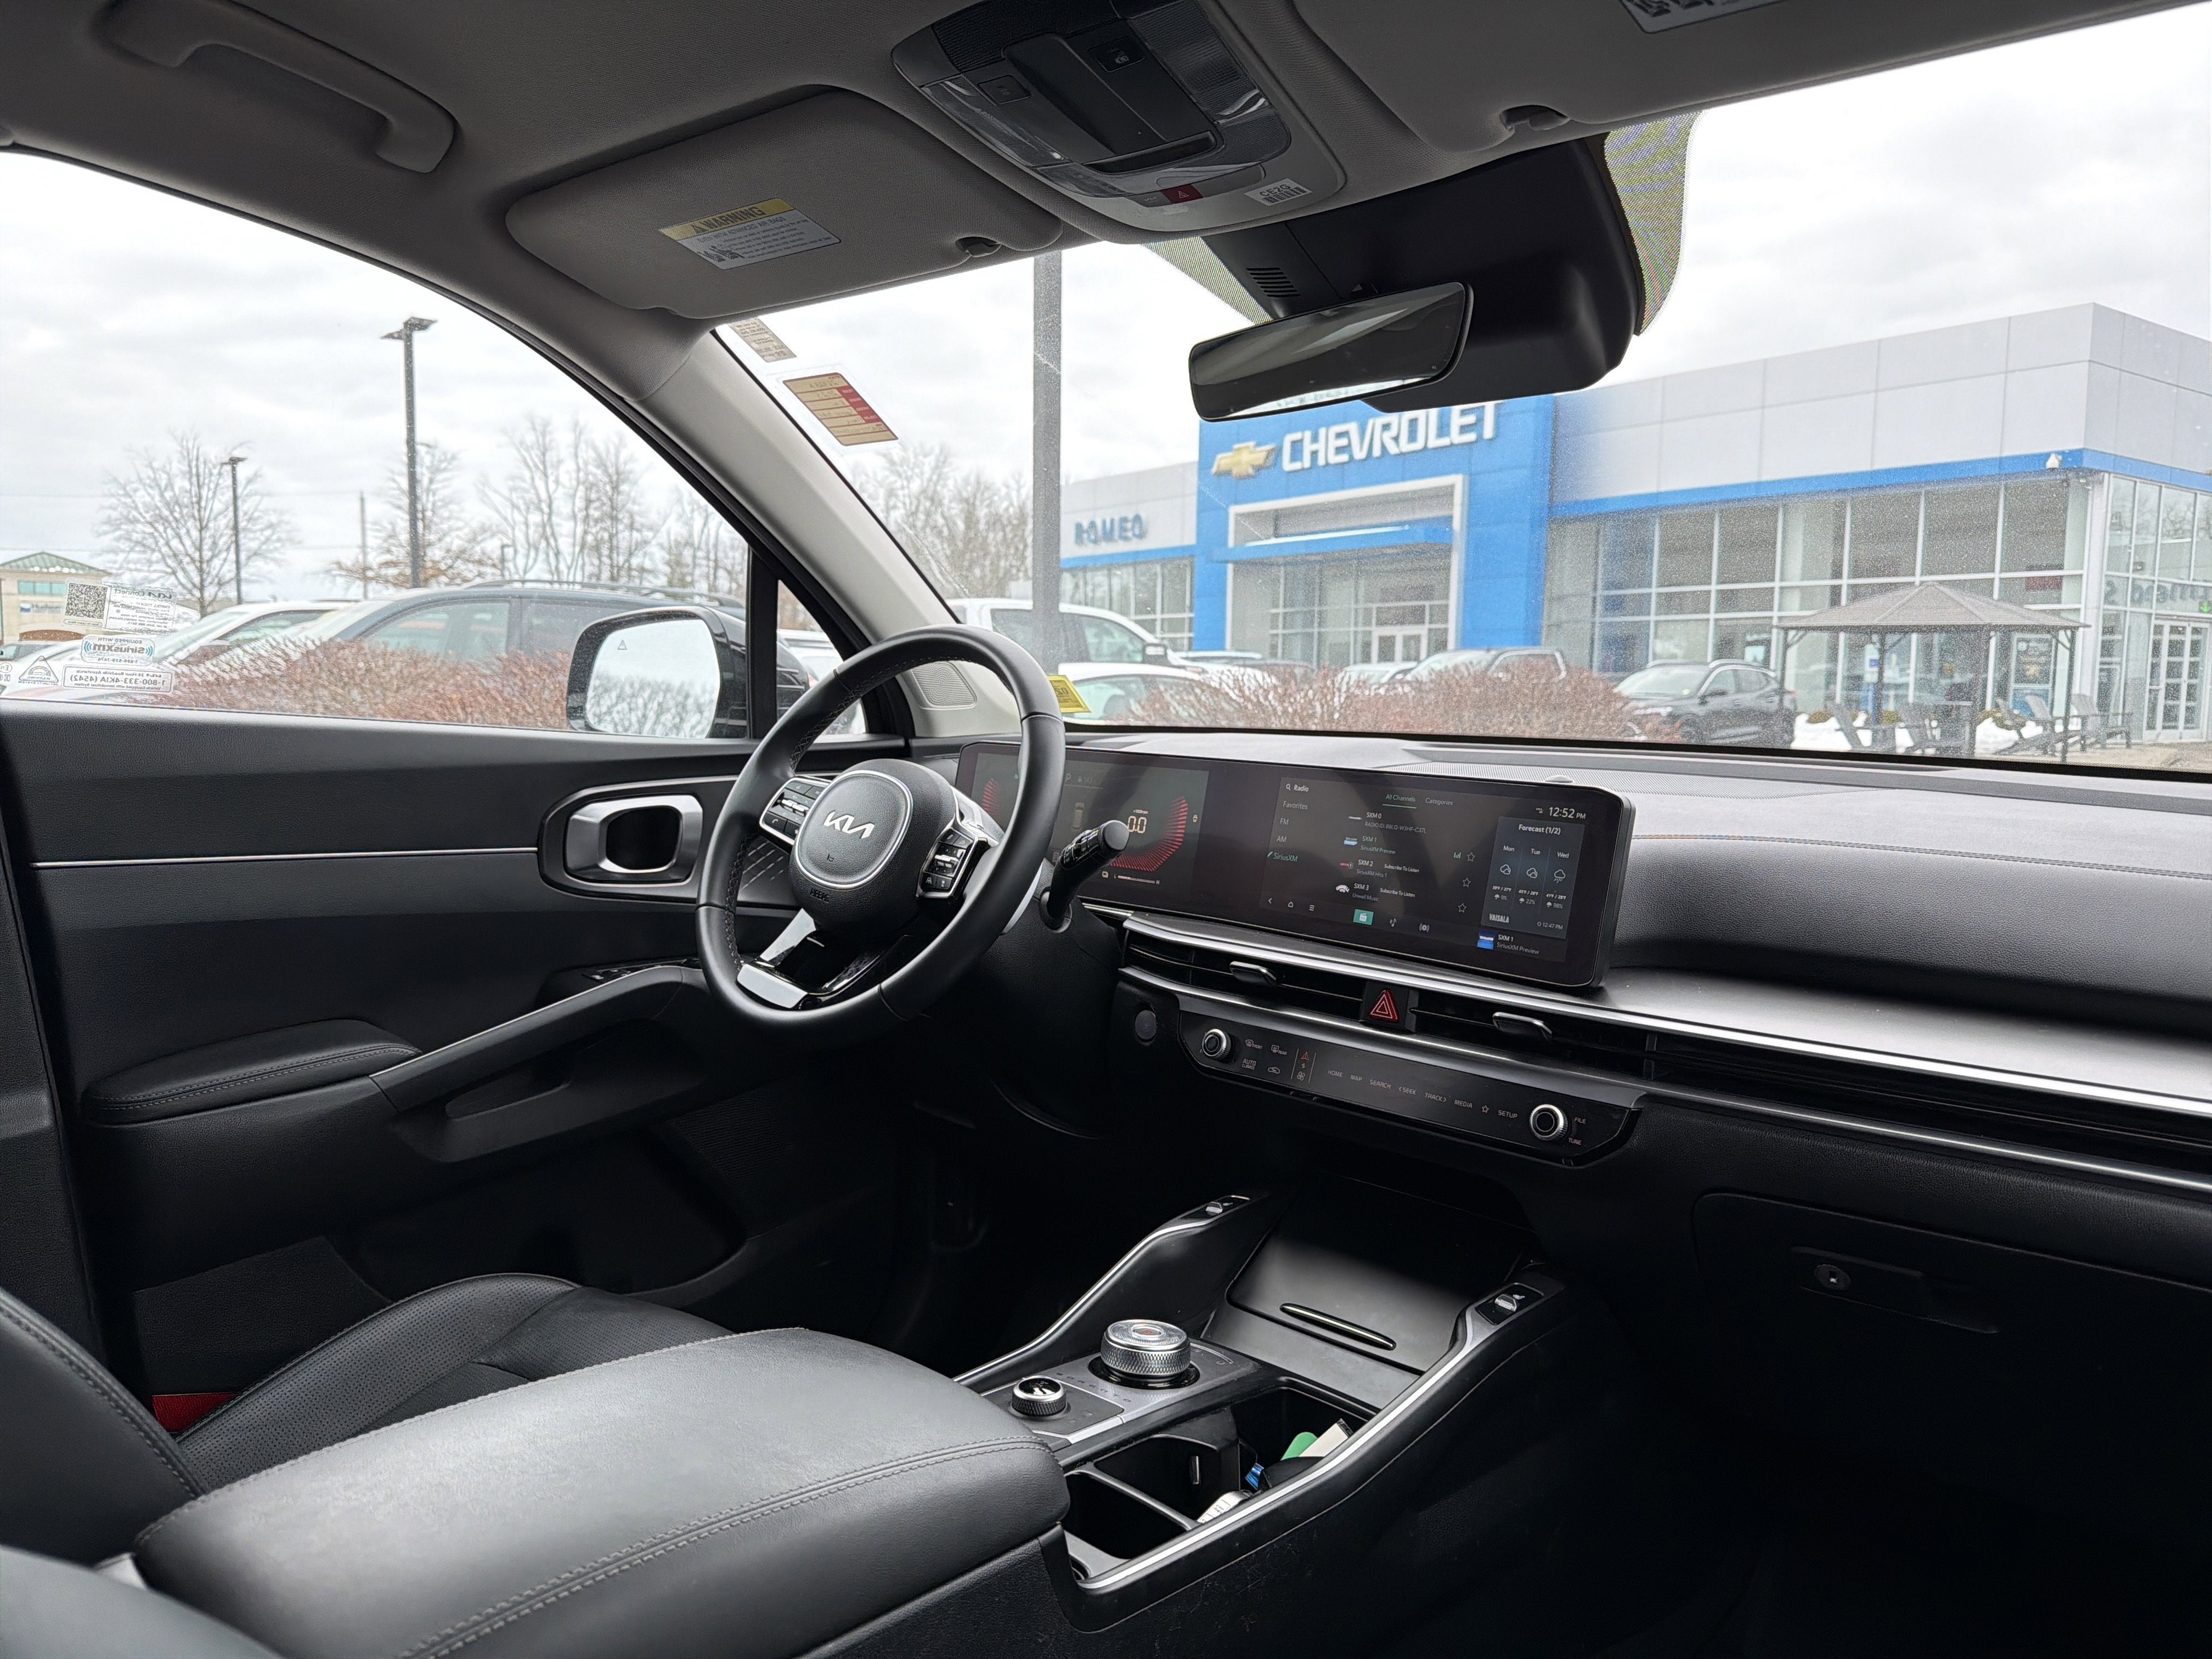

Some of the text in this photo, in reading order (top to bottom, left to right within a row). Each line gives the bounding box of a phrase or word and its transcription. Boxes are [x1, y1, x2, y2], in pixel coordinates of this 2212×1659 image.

[1260, 184, 1291, 196] CE2G
[704, 206, 765, 230] WARNING
[1282, 402, 1503, 472] CHEVROLET
[1073, 514, 1147, 546] ROMEO
[1294, 784, 1309, 792] Radio
[1283, 800, 1308, 810] Favorites
[1425, 797, 1453, 806] Categories
[1549, 806, 1575, 819] 12:52
[823, 810, 876, 839] KIA
[1127, 816, 1147, 834] 0.0
[1519, 824, 1561, 835] Forecast (1/2)
[1273, 853, 1297, 862] SiriusXM
[1489, 913, 1509, 923] VAISALA
[1497, 942, 1539, 955] SiriusXM Preview
[1328, 1069, 1343, 1077] HOME
[1369, 1079, 1391, 1089] SEARCH
[1454, 1099, 1473, 1109] MEDIA
[1498, 1109, 1518, 1119] SETUP
[1574, 1116, 1587, 1125] FILE
[1568, 1137, 1582, 1146] TUNE
